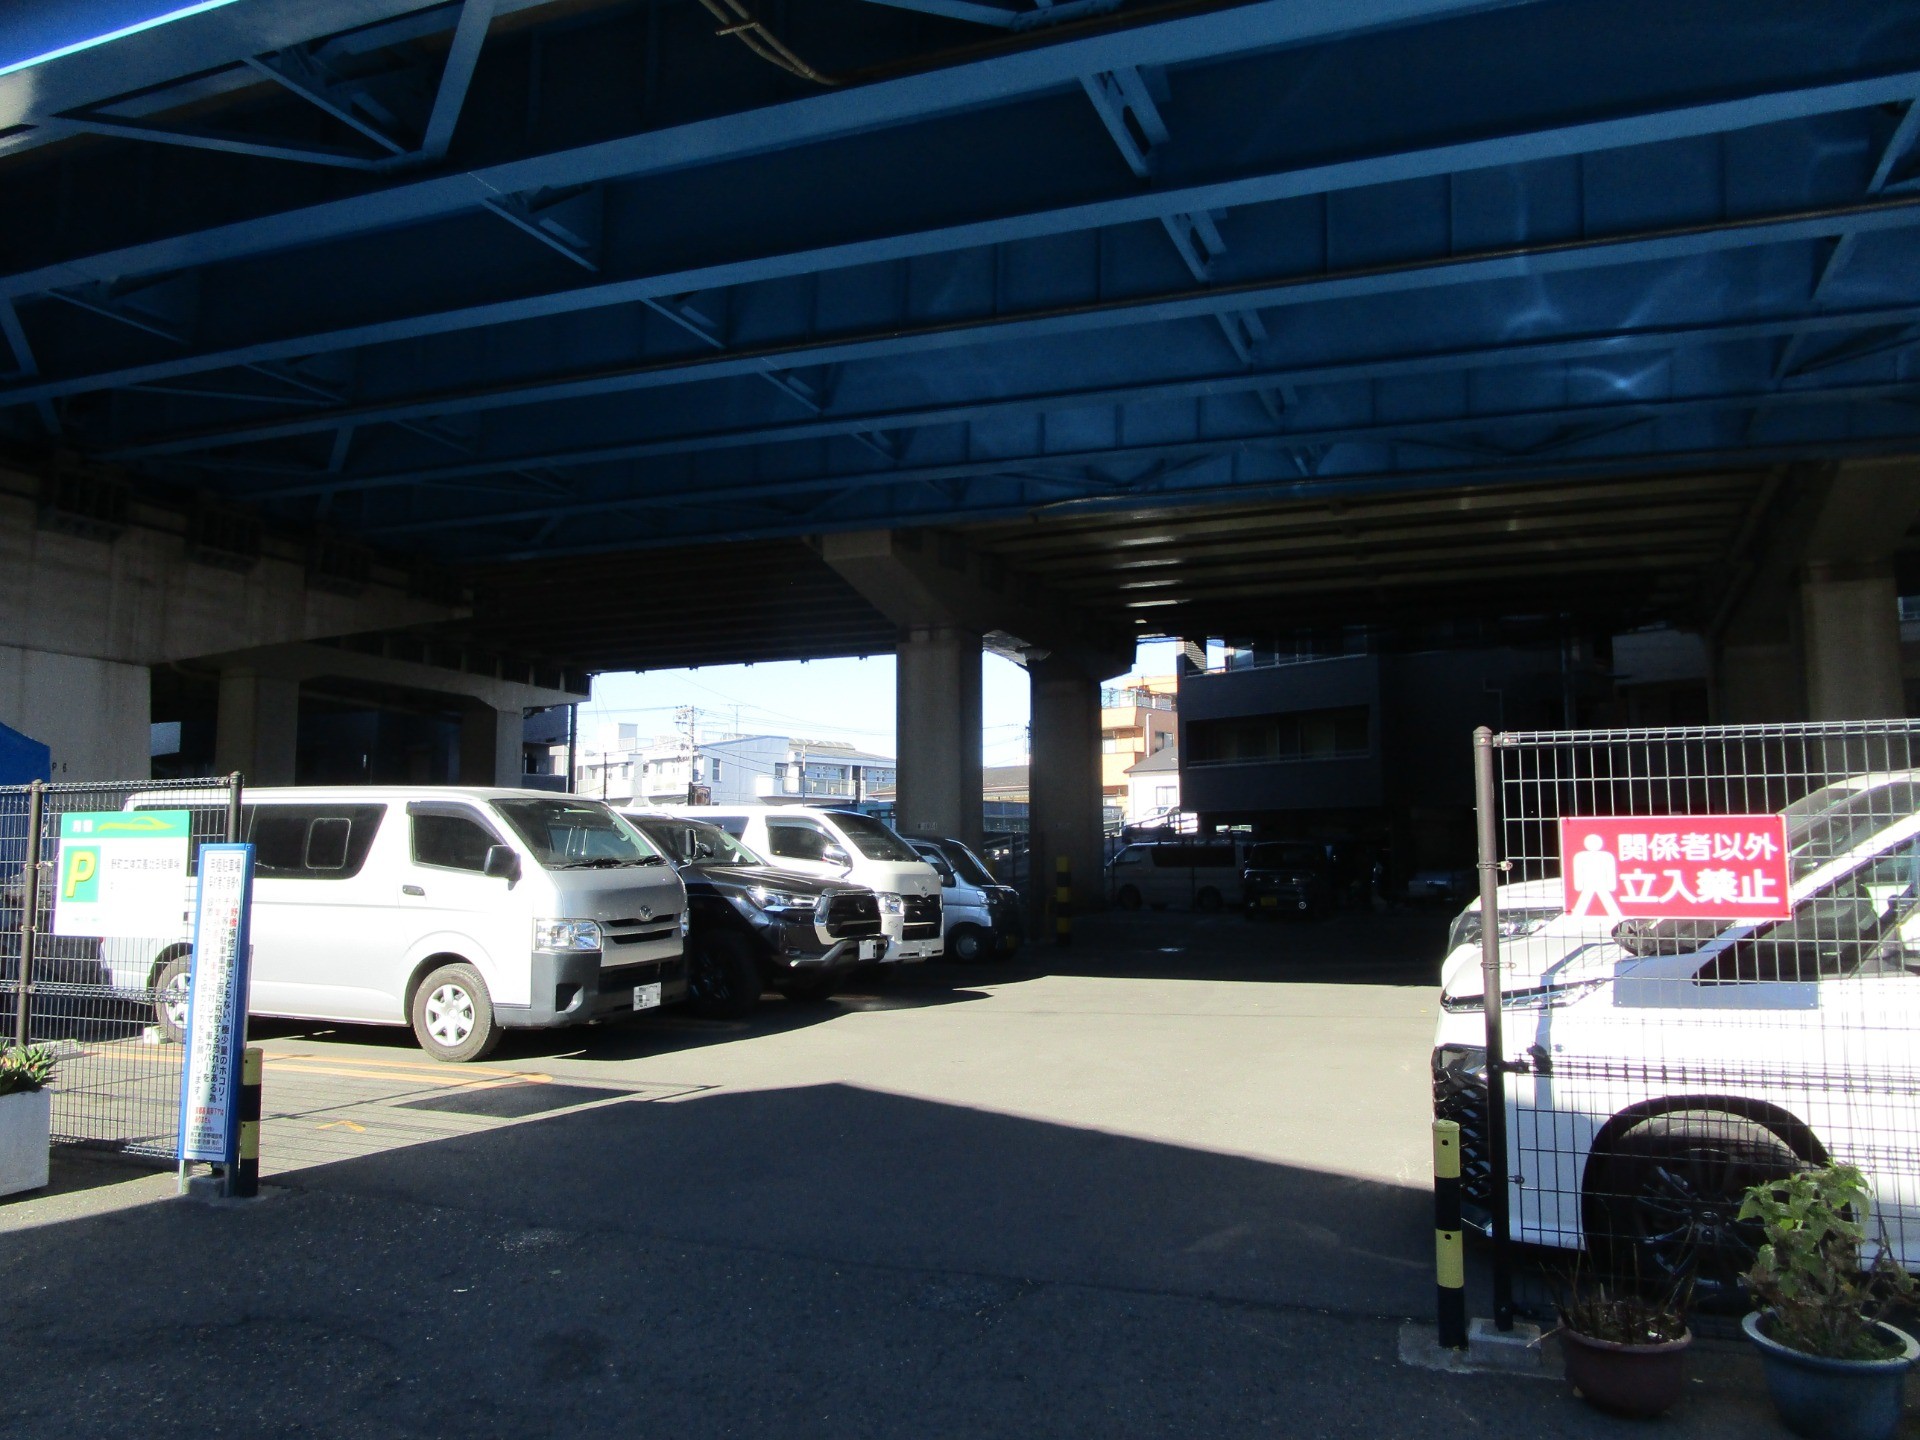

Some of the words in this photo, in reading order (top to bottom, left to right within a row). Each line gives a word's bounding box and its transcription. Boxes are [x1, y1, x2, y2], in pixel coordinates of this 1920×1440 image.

[1617, 832, 1779, 862] 関係者以外
[65, 850, 96, 898] P
[1619, 868, 1779, 904] 立入禁止
